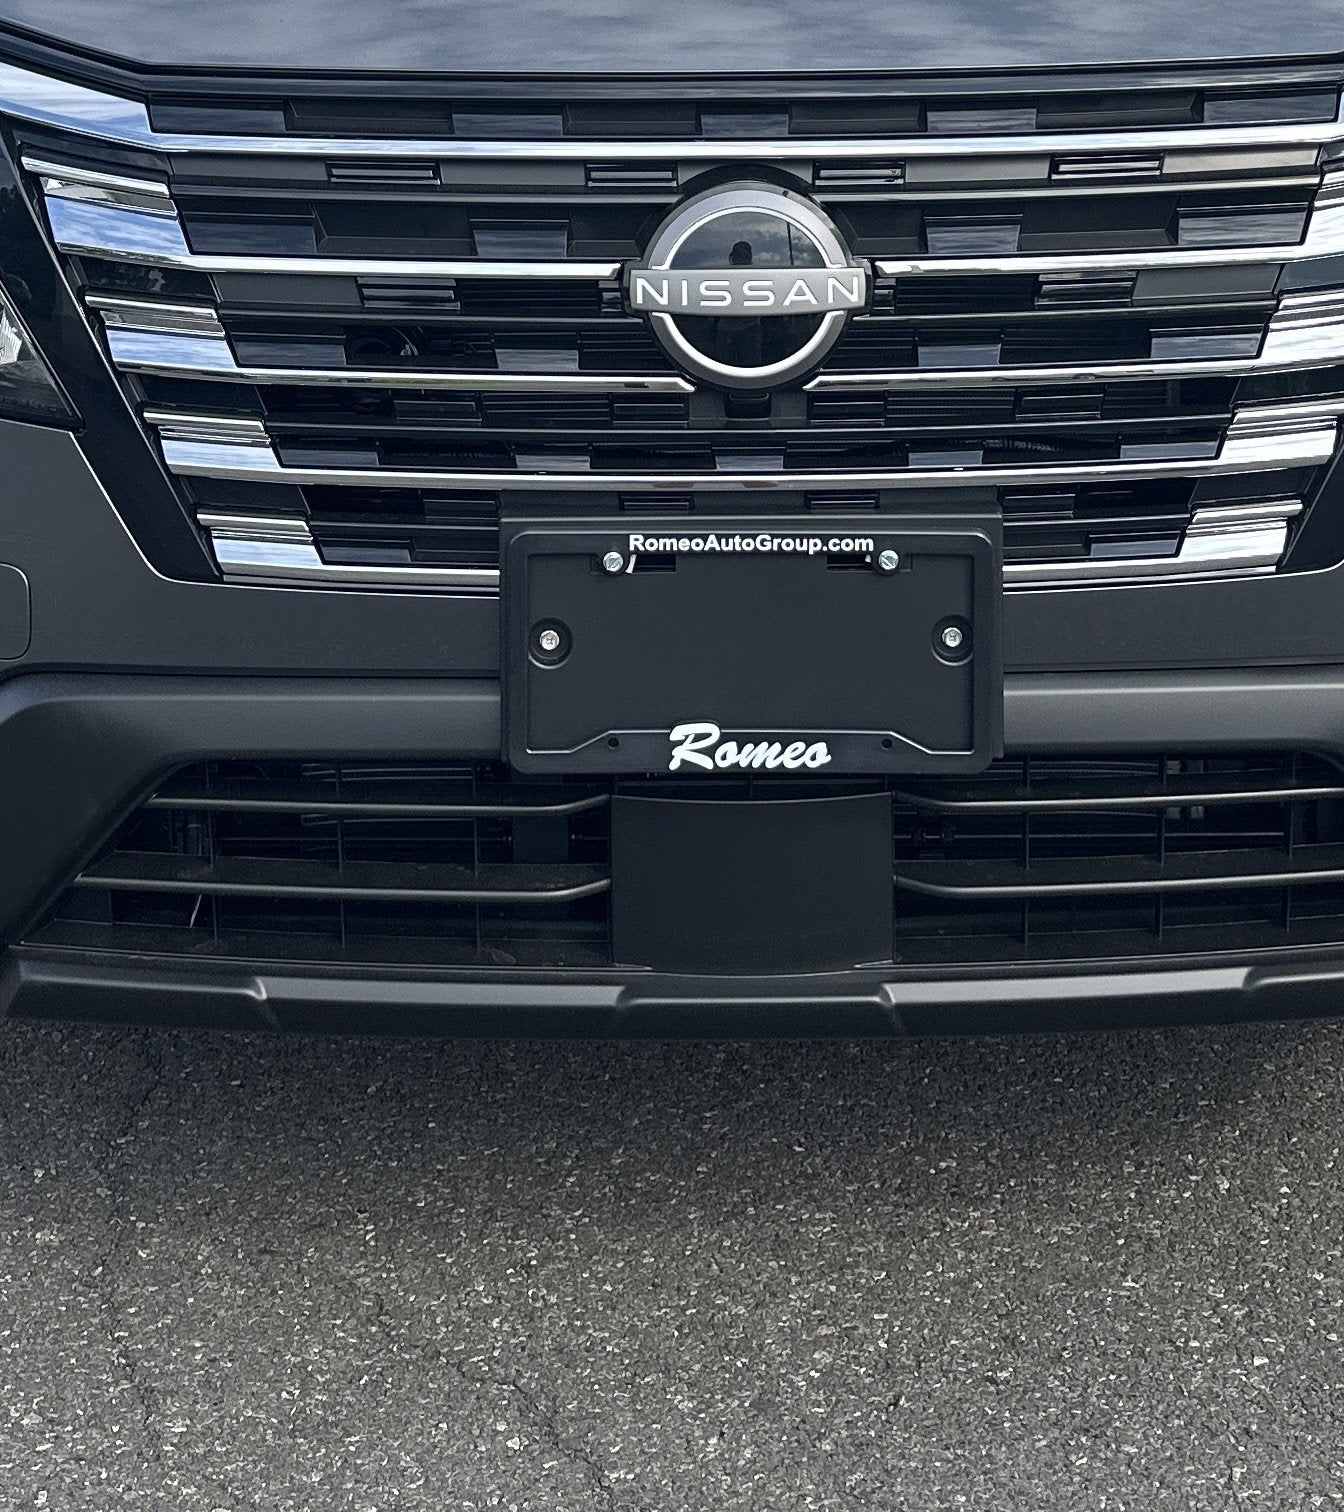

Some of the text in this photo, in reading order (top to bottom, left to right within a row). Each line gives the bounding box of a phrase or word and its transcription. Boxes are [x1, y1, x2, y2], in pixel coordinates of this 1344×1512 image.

[635, 276, 860, 307] NISSAN
[629, 533, 874, 555] RomeoAutoGroup.com
[668, 721, 832, 771] Romeo
